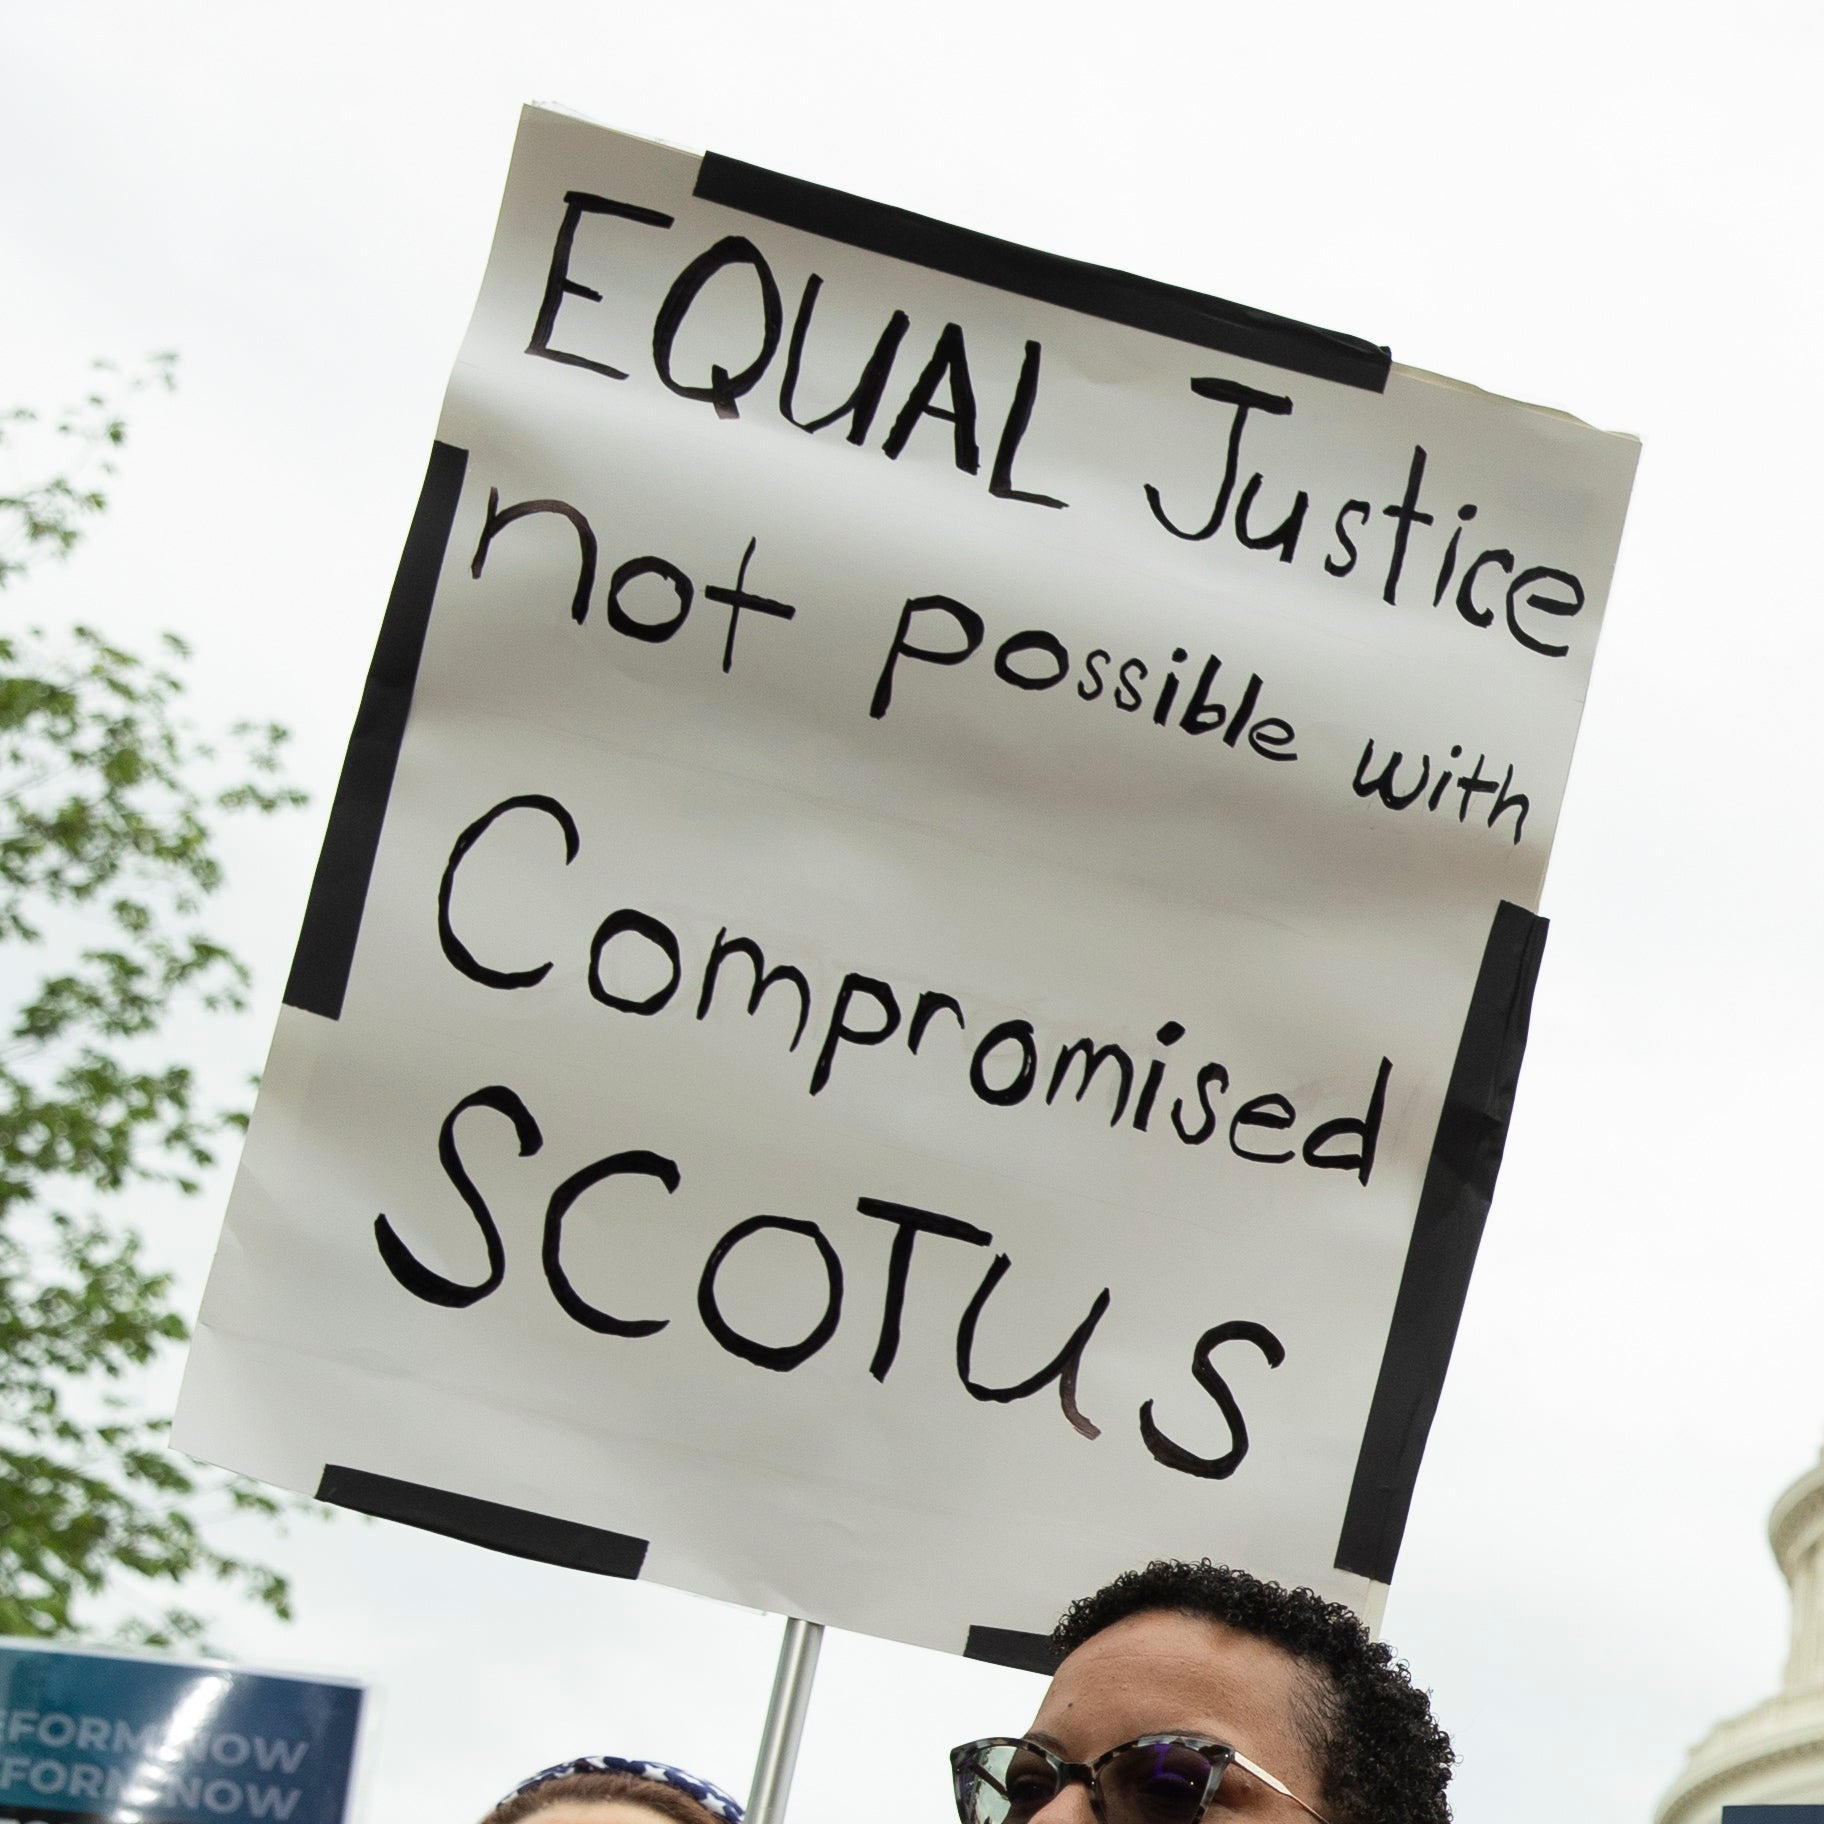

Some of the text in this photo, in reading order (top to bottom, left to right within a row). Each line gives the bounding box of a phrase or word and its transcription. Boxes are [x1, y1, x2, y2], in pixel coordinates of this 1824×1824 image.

[525, 191, 1585, 658] EQUAL Justice
[470, 487, 1530, 844] not possible with
[437, 794, 1390, 1187] Compromised
[374, 1085, 1286, 1480] SCOTUS
